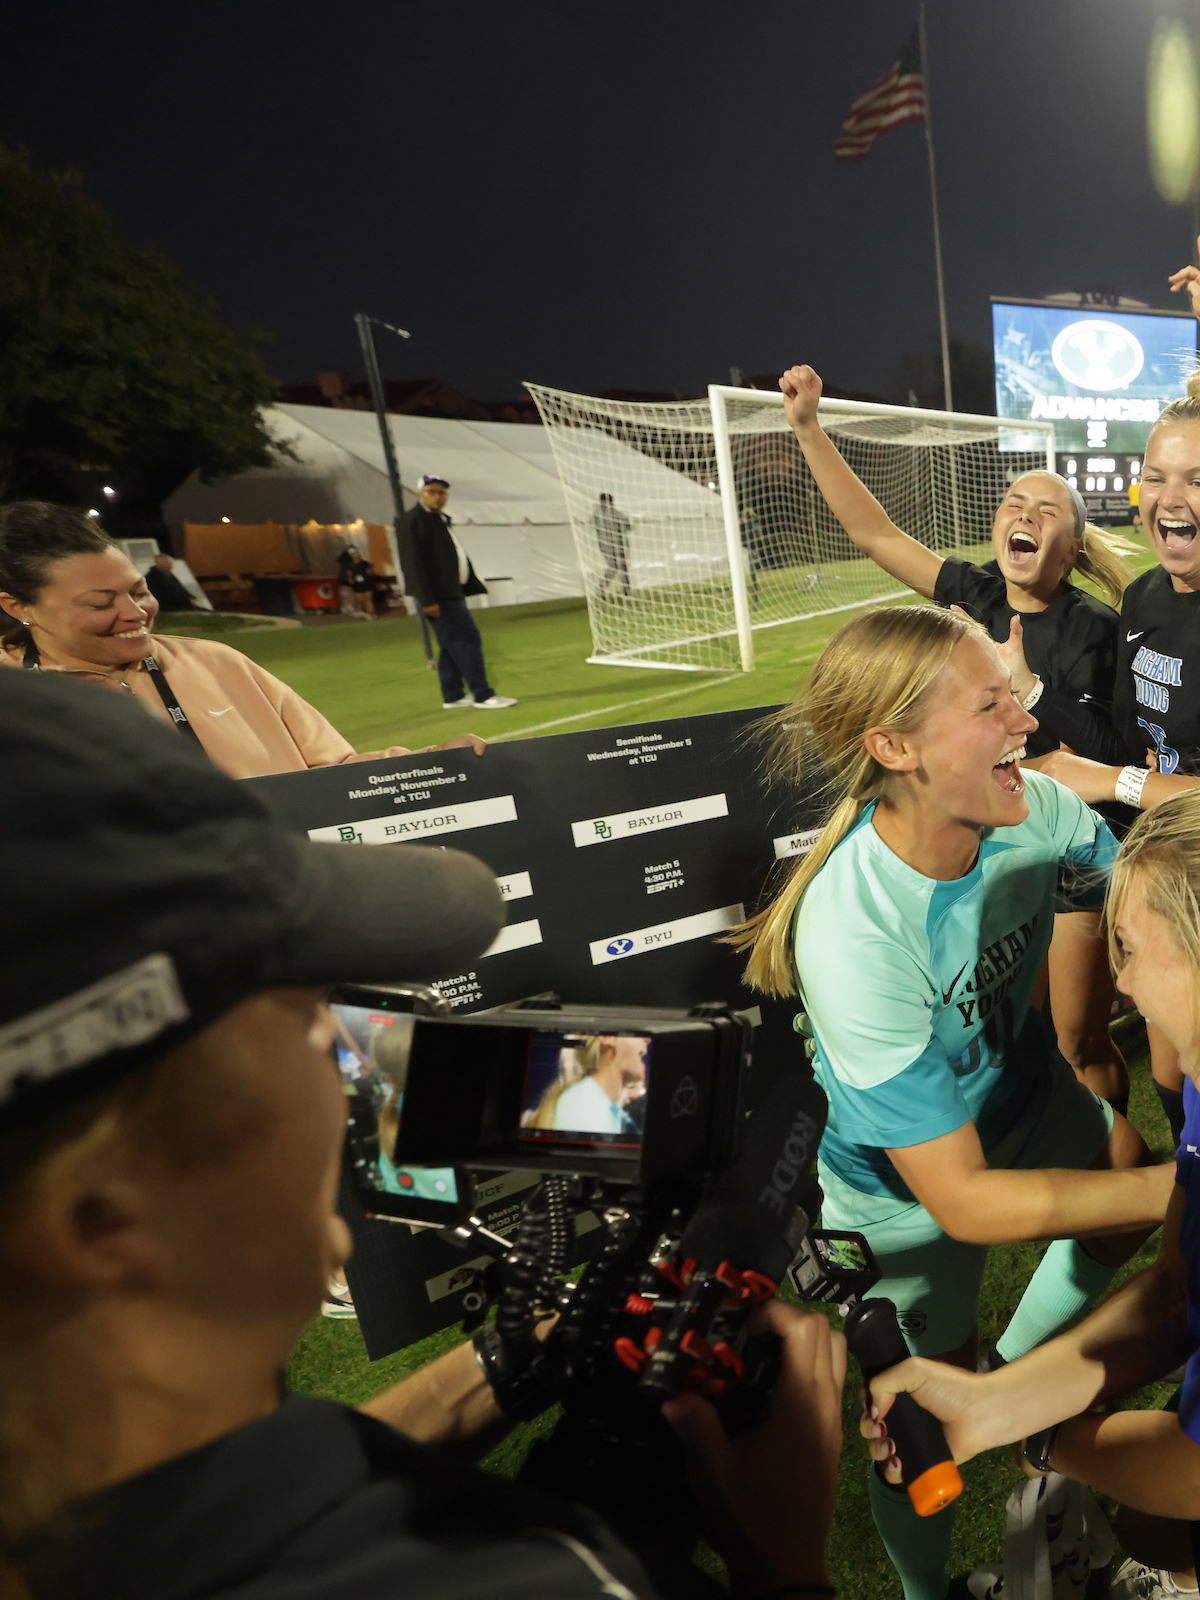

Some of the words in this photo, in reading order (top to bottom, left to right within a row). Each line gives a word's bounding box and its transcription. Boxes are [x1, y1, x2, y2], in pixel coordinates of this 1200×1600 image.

[1131, 646, 1183, 687] RIGHAM
[1134, 674, 1170, 713] OUNG
[616, 733, 662, 747] Semifinals
[587, 746, 641, 762] Wednesday,
[642, 740, 684, 753] November
[685, 738, 692, 746] 5
[629, 757, 639, 766] at
[640, 754, 657, 764] TCU
[368, 766, 444, 784] Quarterfinals
[348, 785, 400, 800] Monday,
[400, 775, 457, 792] November
[458, 773, 467, 782] 3
[393, 795, 407, 804] at
[408, 791, 431, 802] TCU
[384, 814, 458, 836] BAYLOR
[628, 810, 684, 829] BAYLOR
[645, 862, 673, 874] Match
[645, 873, 665, 883] 4:30
[665, 869, 684, 880] P.M.
[647, 878, 685, 895] ESPN+
[644, 931, 673, 945] BYU
[432, 975, 467, 989] Match
[468, 972, 477, 980] 2
[459, 982, 481, 994] P.M.
[487, 1204, 519, 1221] Match
